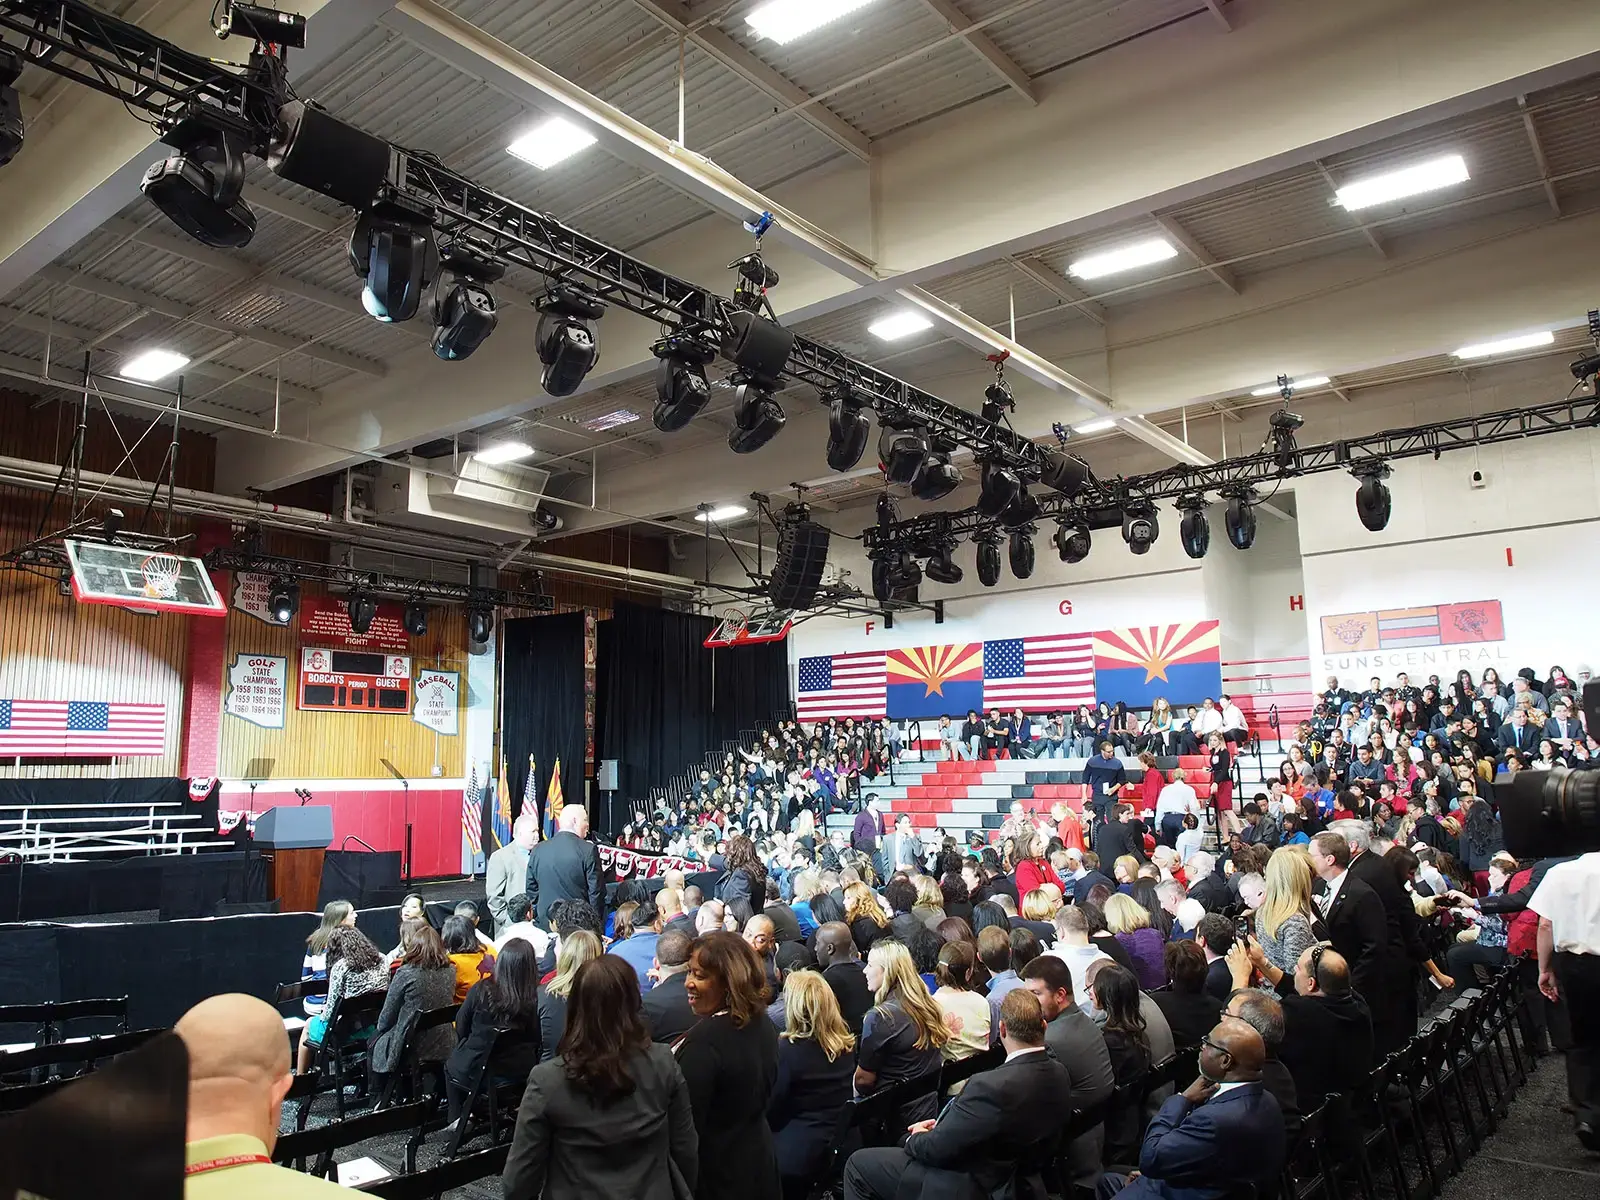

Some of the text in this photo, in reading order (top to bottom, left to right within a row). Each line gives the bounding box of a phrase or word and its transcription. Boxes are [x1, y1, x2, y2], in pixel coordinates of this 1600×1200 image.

[1506, 548, 1513, 566] I
[245, 602, 260, 611] 1963
[1059, 600, 1072, 615] G
[1290, 595, 1303, 611] H
[866, 622, 874, 635] F
[345, 637, 367, 645] FIGHT!
[248, 659, 276, 668] GOLF
[252, 668, 270, 676] STATE
[243, 676, 278, 685] CHAMPIONS
[308, 673, 344, 684] BOBCATS
[376, 678, 400, 688] GUEST
[418, 675, 455, 692] BASEBALL
[236, 685, 251, 693] 1958
[429, 700, 444, 708] STATE
